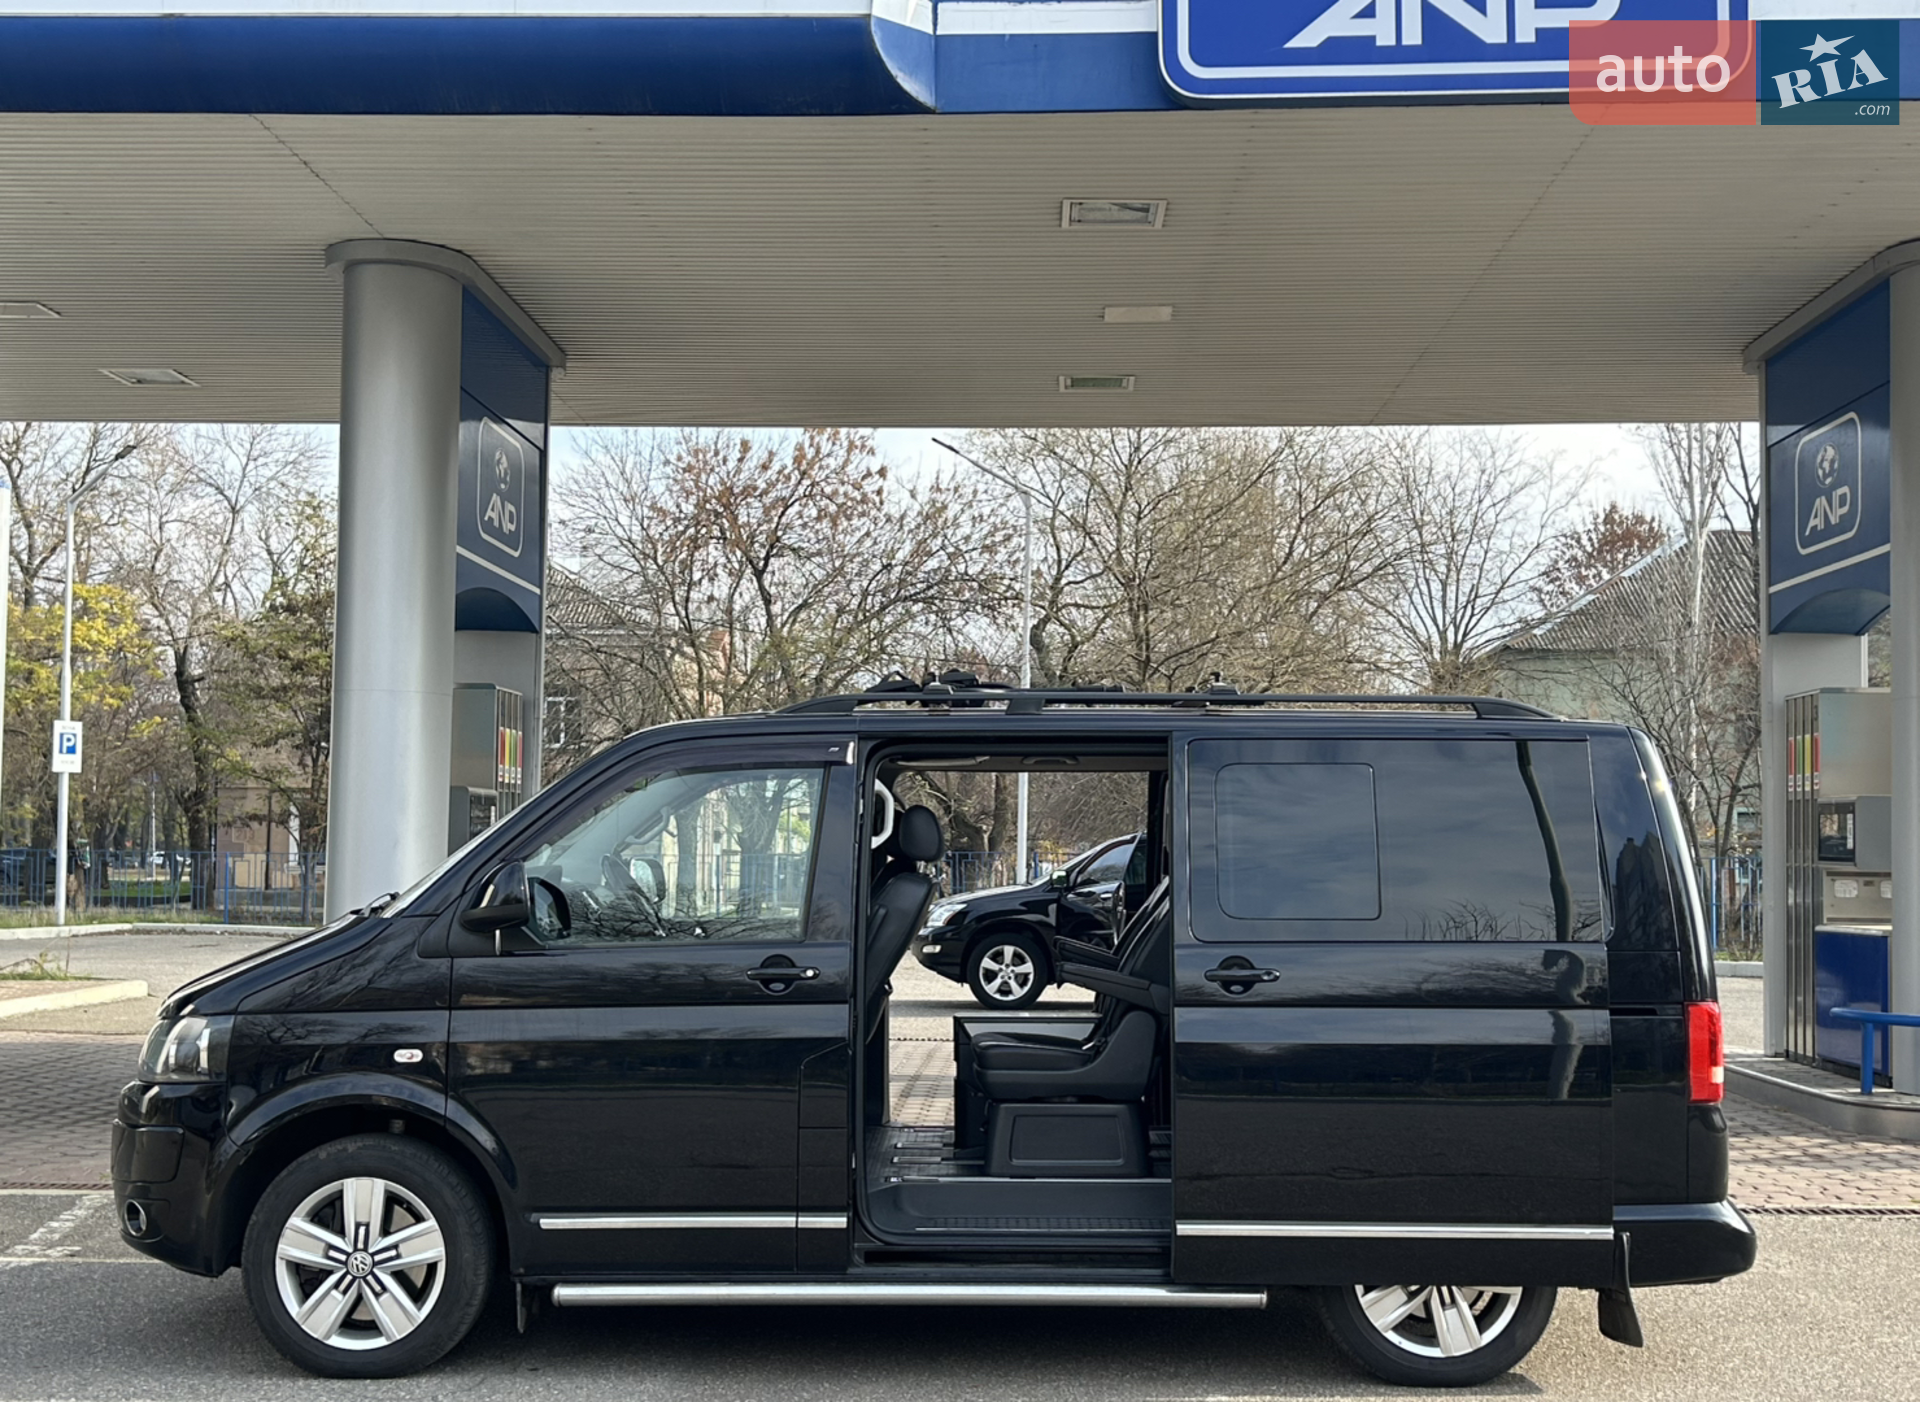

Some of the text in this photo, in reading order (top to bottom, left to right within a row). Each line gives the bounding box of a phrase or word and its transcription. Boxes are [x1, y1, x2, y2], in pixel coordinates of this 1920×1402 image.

[484, 492, 517, 535] ANP
[1804, 485, 1851, 536] ANP
[62, 734, 76, 753] P
